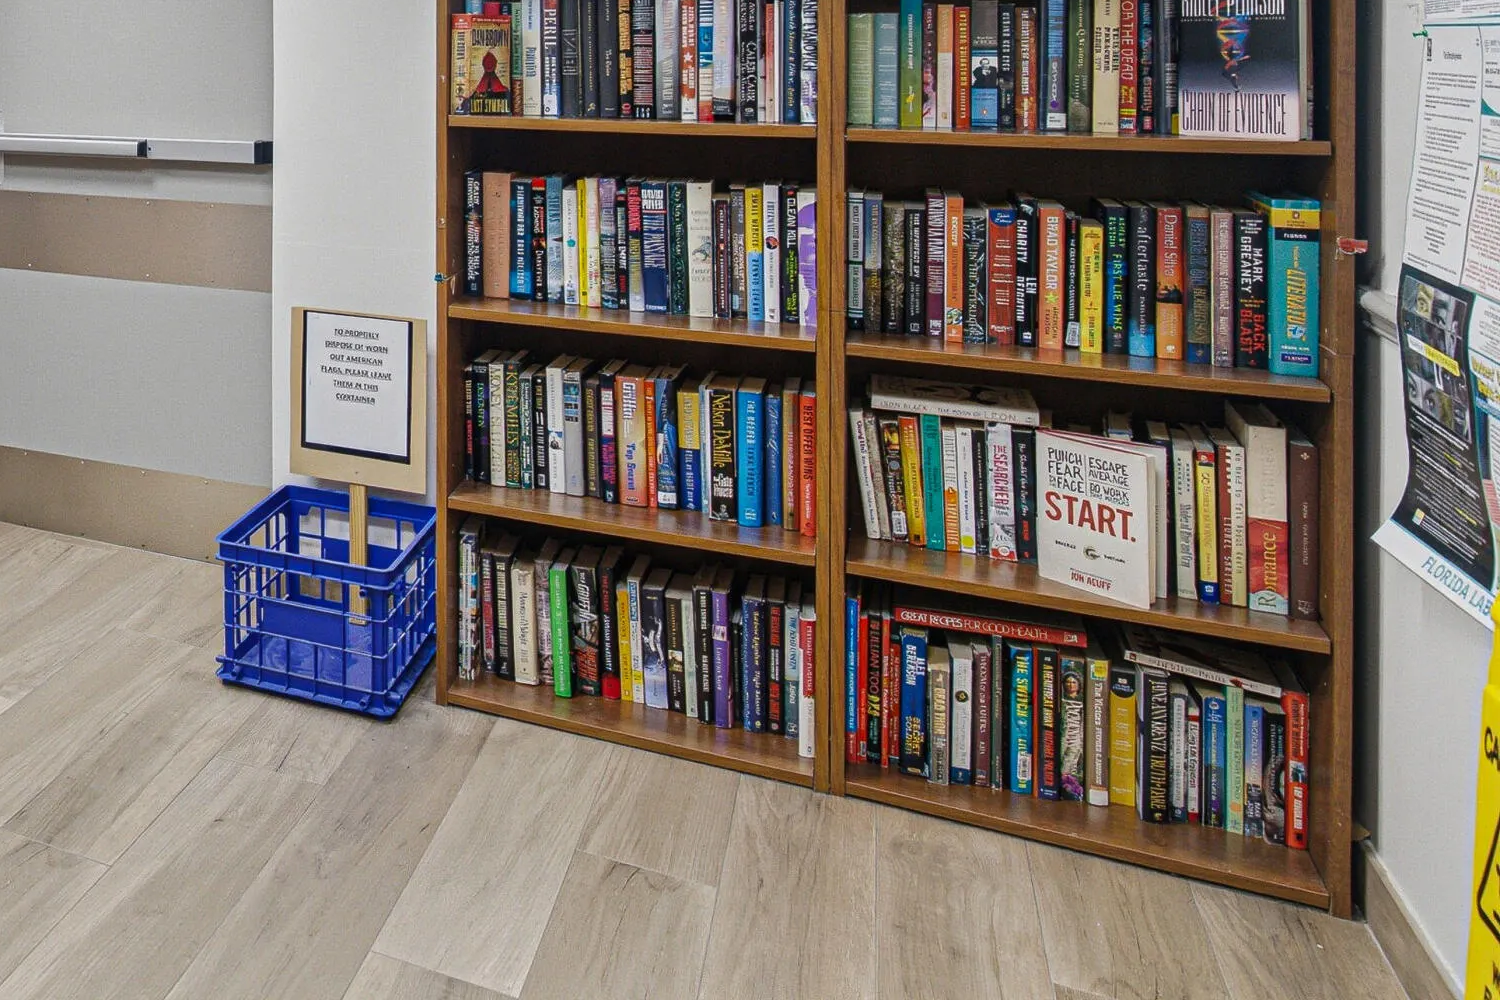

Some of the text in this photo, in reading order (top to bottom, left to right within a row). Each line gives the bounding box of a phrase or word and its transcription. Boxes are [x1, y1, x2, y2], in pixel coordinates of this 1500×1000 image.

[471, 28, 509, 47] DAN BROWN
[544, 9, 556, 49] PERIL
[802, 23, 817, 71] EVANOVICH
[1121, 24, 1134, 47] THE
[746, 41, 757, 102] CALEB CARR
[1121, 49, 1134, 81] DEAD
[470, 98, 484, 113] LOST
[1182, 90, 1287, 135] CHAIN OF EVIDENCE
[642, 189, 663, 199] DAVID
[643, 215, 666, 268] THE PASSAGE
[786, 198, 796, 248] CLEAN KILL
[1017, 219, 1027, 263] CHARITY
[968, 251, 979, 281] IN THE
[1046, 216, 1058, 289] BRAD TAYLOR
[1137, 227, 1151, 290] aftertaste
[1164, 215, 1177, 276] Daniel Silva
[1026, 277, 1036, 293] LEN
[1112, 254, 1122, 330] FIRST LIE WINS
[1240, 236, 1252, 353] GREANEY BLAST
[1253, 247, 1264, 350] MARK BACK
[325, 341, 388, 354] DISPOSE OF WORN
[334, 328, 379, 339] TO PROPERLY
[330, 353, 383, 366] OUT AMERICAN
[345, 368, 369, 377] PLEASE
[371, 371, 392, 380] LEAVE
[333, 380, 353, 389] THEM
[363, 384, 379, 392] THIS
[336, 393, 375, 405] CONTAINER
[623, 382, 637, 420] Griffin
[506, 371, 519, 445] KYLE MILLS
[711, 394, 732, 467] Nelson DeMille
[803, 406, 814, 480] BEST OFFER WINS
[1047, 447, 1083, 467] PUNCH
[1048, 461, 1083, 479] FEAR
[1089, 459, 1128, 477] ESCAPE
[994, 454, 1009, 505] SEARCHER
[1057, 477, 1084, 494] FACE
[1089, 470, 1129, 487] AVERAGE
[1089, 483, 1129, 501] DO WORK
[1044, 491, 1136, 542] START.
[1223, 516, 1232, 594] LIONEL SHRIVER
[1257, 532, 1278, 607] Romance
[1070, 571, 1111, 591] JON ACUFF
[1421, 556, 1470, 600] FLORIDA
[578, 584, 595, 620] GRIFFIN
[900, 610, 1048, 640] GREAT RECIPES FOR GOOD HEALTH
[868, 629, 880, 694] LILLIAN TOO
[905, 644, 917, 686] BERENSON
[916, 657, 926, 676] ALEX
[1017, 655, 1030, 716] THE SWITCH
[1043, 671, 1053, 727] HEARTBEAT AWAY
[1094, 683, 1103, 725] The Victors
[935, 687, 946, 734] BRAD THOR
[1149, 681, 1167, 809] JAYNE ANN KRENTZ TRUTH DARE
